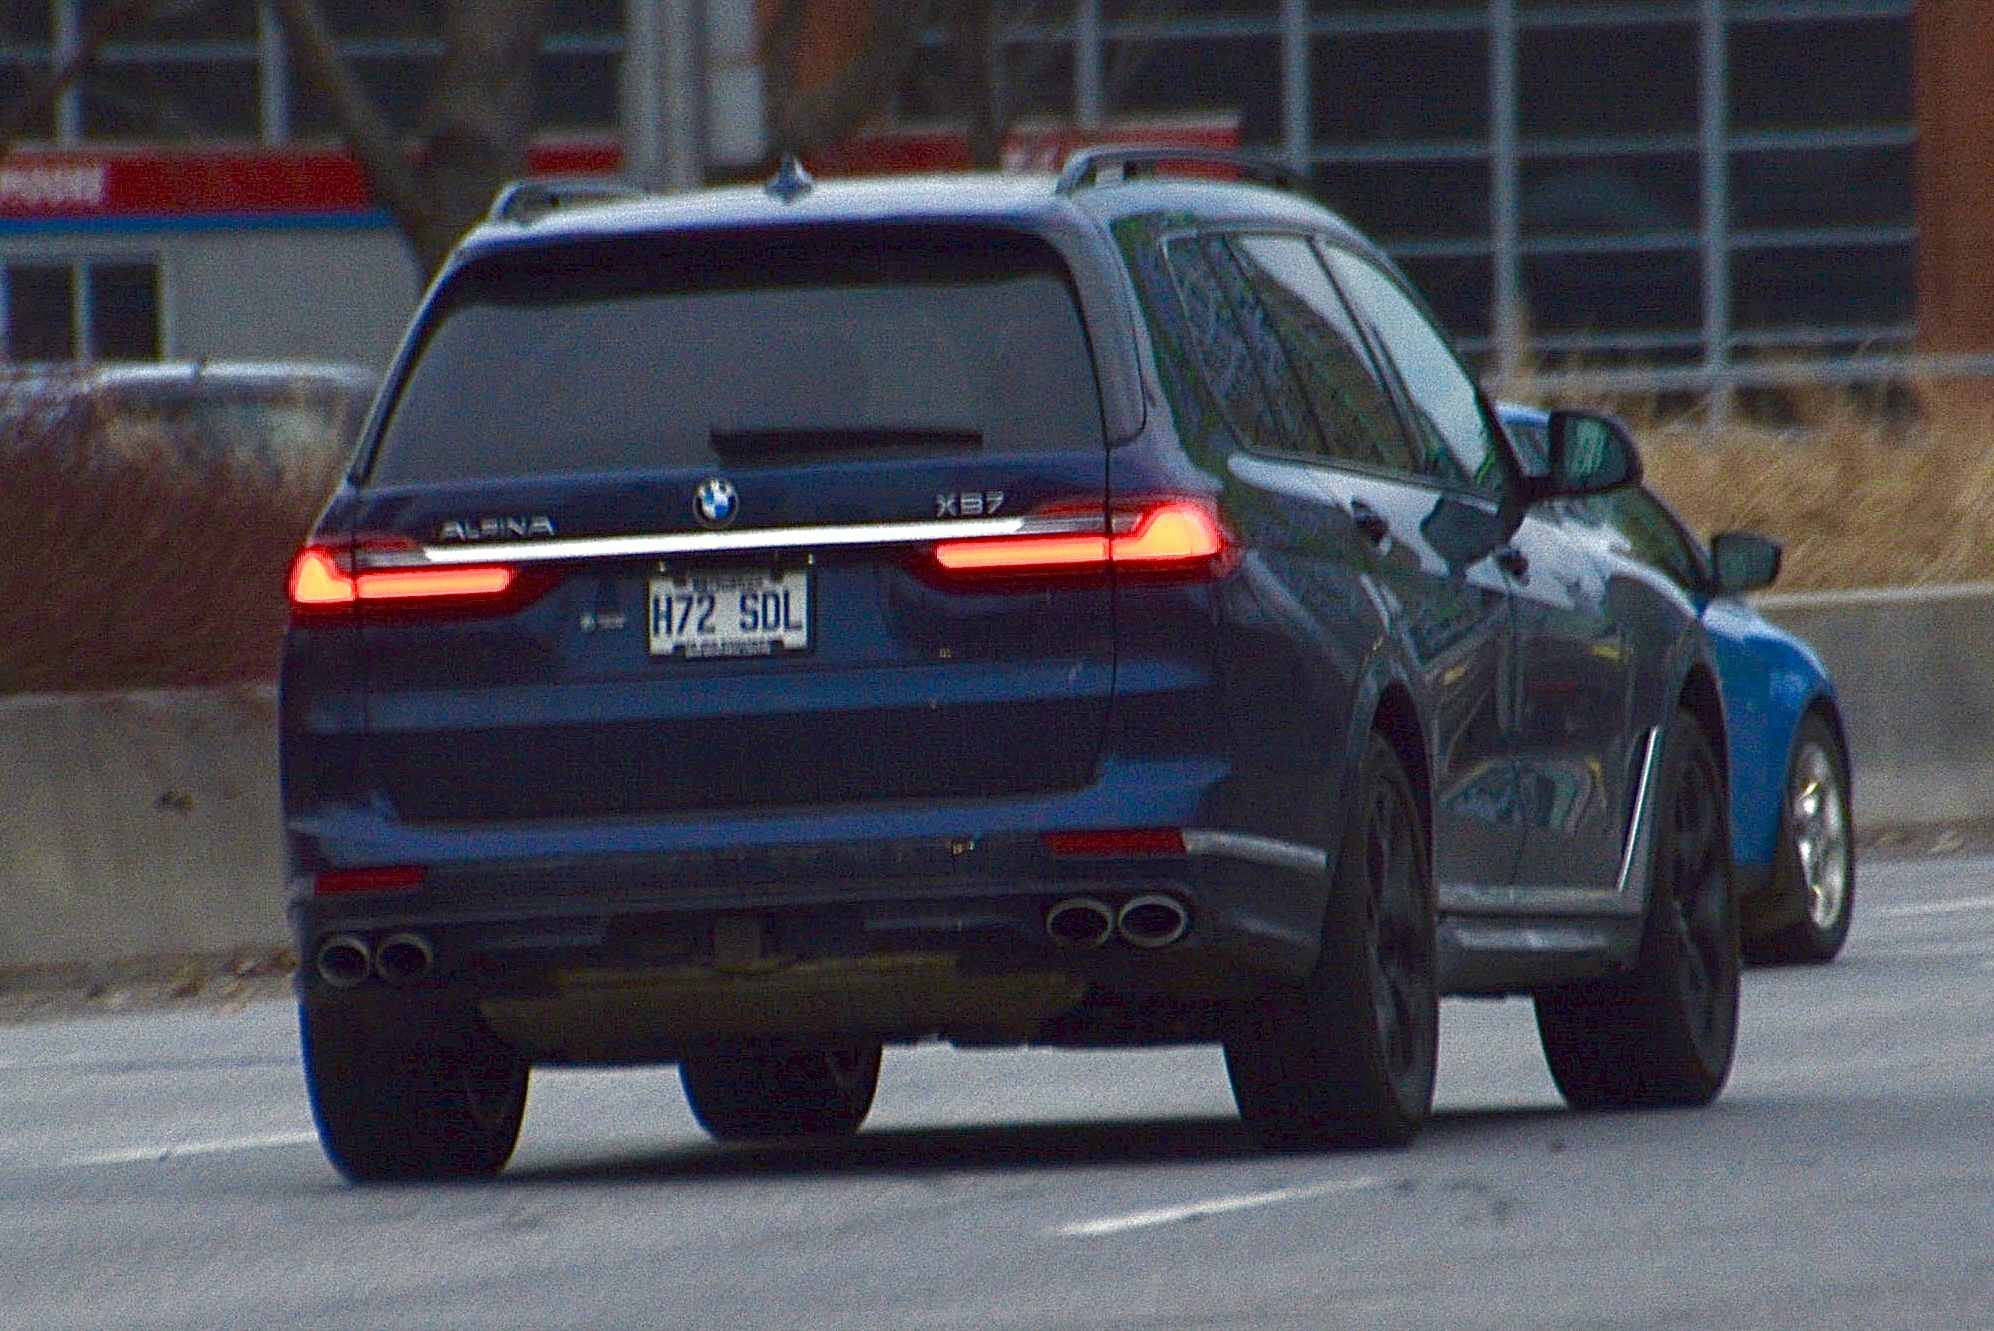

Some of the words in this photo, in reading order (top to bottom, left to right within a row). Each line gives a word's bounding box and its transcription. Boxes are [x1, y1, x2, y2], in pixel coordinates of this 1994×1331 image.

[935, 490, 1004, 516] XB7
[441, 516, 556, 540] ALPINA
[652, 594, 716, 635] H72
